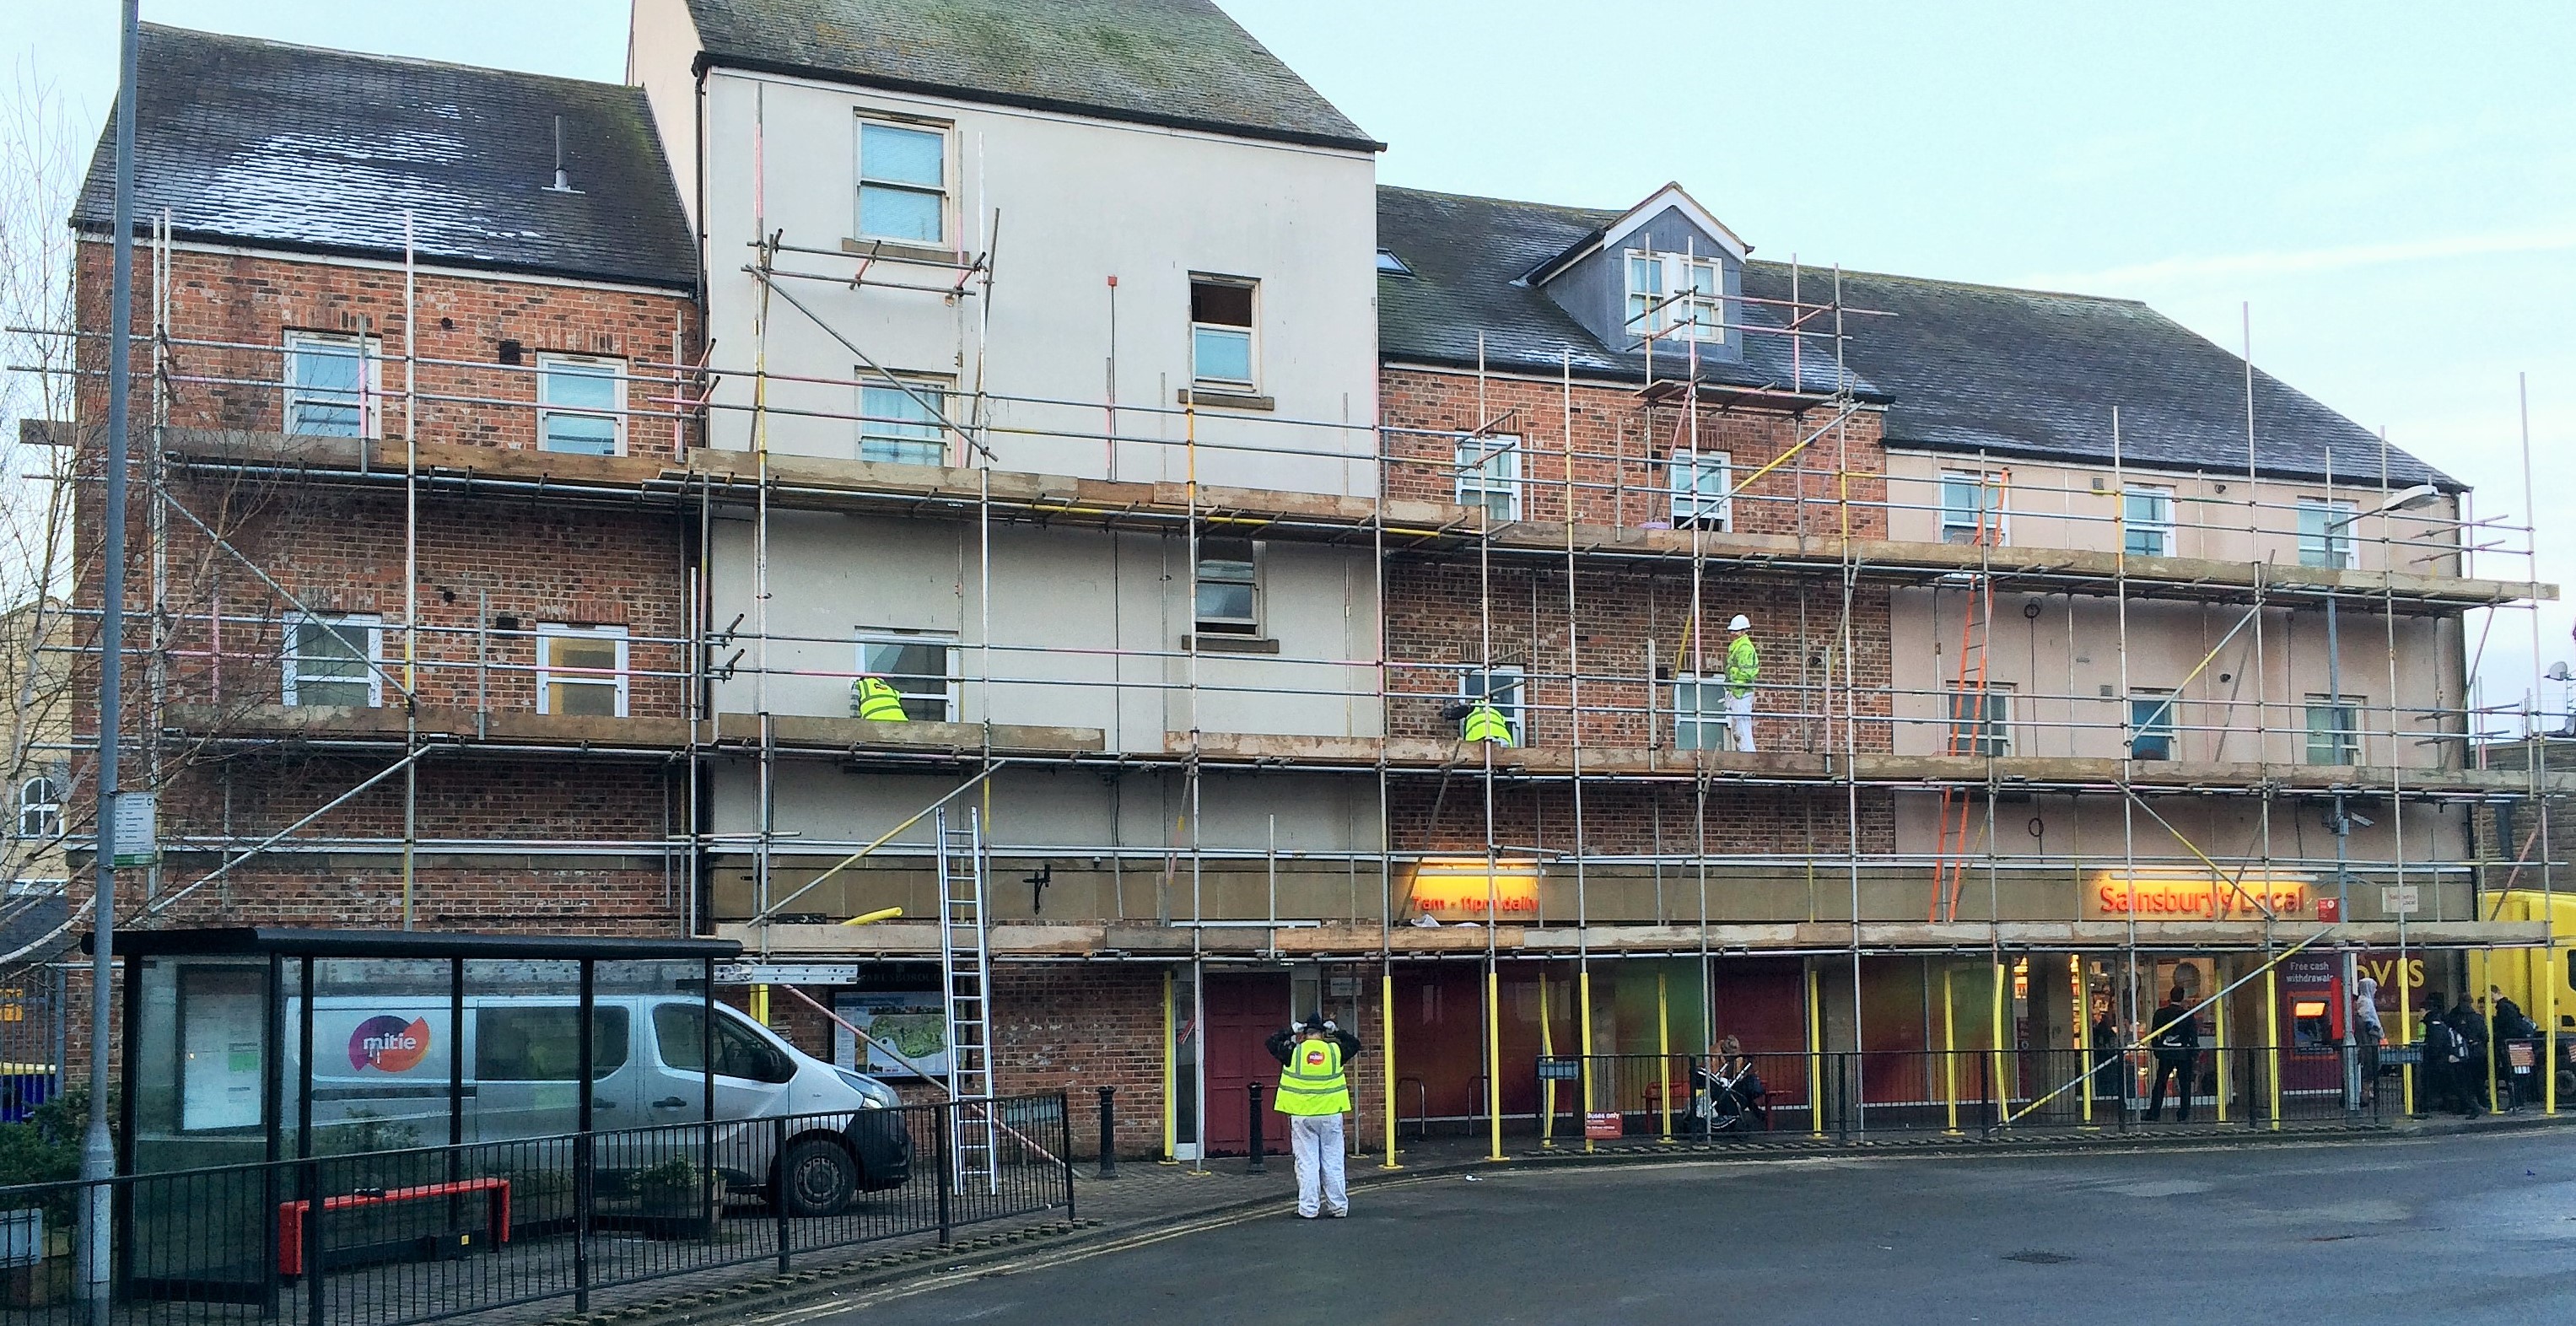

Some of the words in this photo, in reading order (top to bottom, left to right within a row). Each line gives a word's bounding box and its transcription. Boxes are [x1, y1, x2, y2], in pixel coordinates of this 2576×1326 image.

[1412, 895, 1445, 912] 7am
[1502, 896, 1539, 913] daily
[2099, 885, 2234, 918] Sainsbury's
[2290, 962, 2309, 971] Free
[2311, 961, 2330, 971] cash
[364, 1032, 417, 1050] mitie
